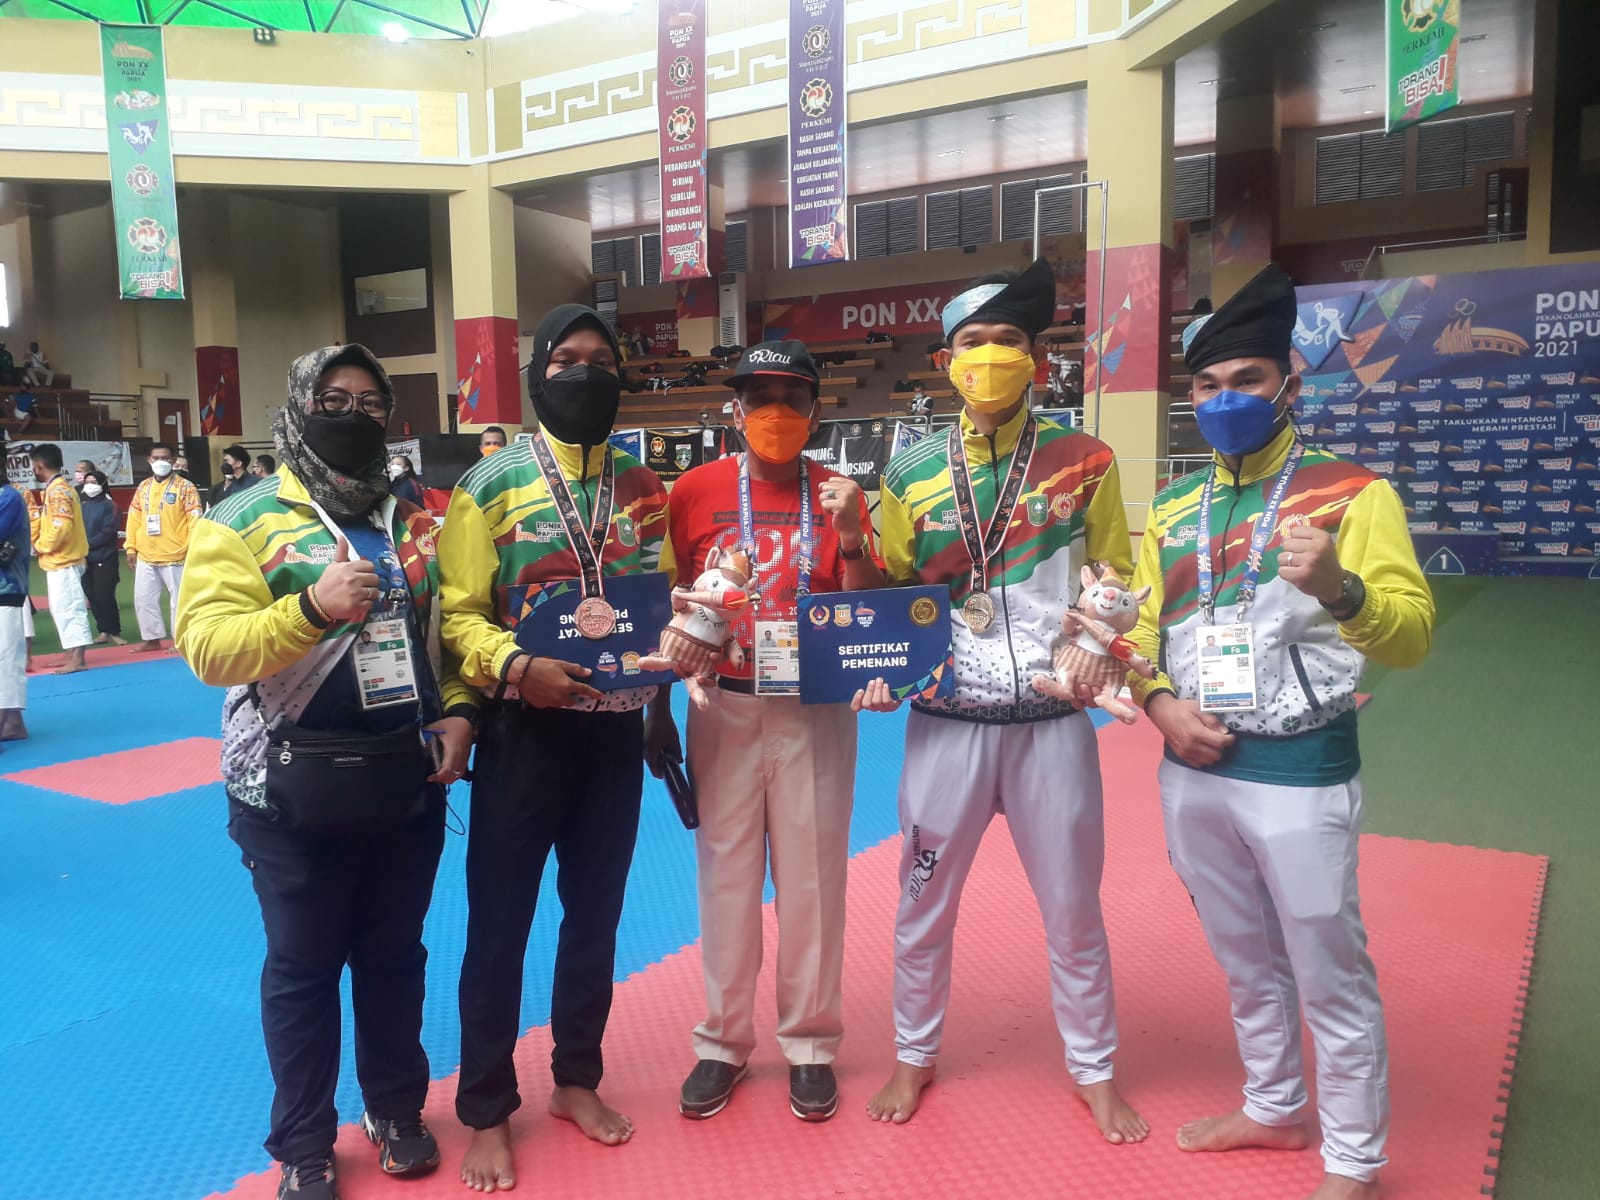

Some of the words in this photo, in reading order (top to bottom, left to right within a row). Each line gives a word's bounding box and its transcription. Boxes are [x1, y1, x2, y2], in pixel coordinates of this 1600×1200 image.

[669, 28, 684, 37] PON
[1399, 61, 1440, 92] TORANG
[801, 117, 833, 128] PERKEMI
[796, 148, 812, 157] TANPA
[664, 159, 701, 173] PERANGILAH
[670, 191, 696, 202] SEBELUM
[666, 223, 687, 233] ORANG
[688, 220, 702, 230] LAIN
[800, 226, 830, 238] TORANG
[1536, 289, 1599, 314] PON
[842, 302, 896, 330] PON
[905, 297, 941, 324] XX
[656, 322, 671, 331] PON
[1535, 319, 1600, 340] PAPU
[1535, 340, 1578, 358] 2021
[1444, 418, 1498, 426] TAKLUKKAN
[1501, 416, 1557, 424] RINTANGAN
[1511, 423, 1556, 431] PRESTASI
[1284, 461, 1295, 475] 2021
[1272, 474, 1289, 500] PAPUA
[1201, 492, 1209, 517] PAPUA
[1270, 500, 1280, 514] XX
[742, 503, 750, 526] PAPUA
[802, 513, 809, 522] XX
[1261, 514, 1272, 528] PON
[1440, 554, 1447, 570] 1
[838, 642, 910, 656] SERTIFIKAT
[842, 656, 908, 669] PEMENANG
